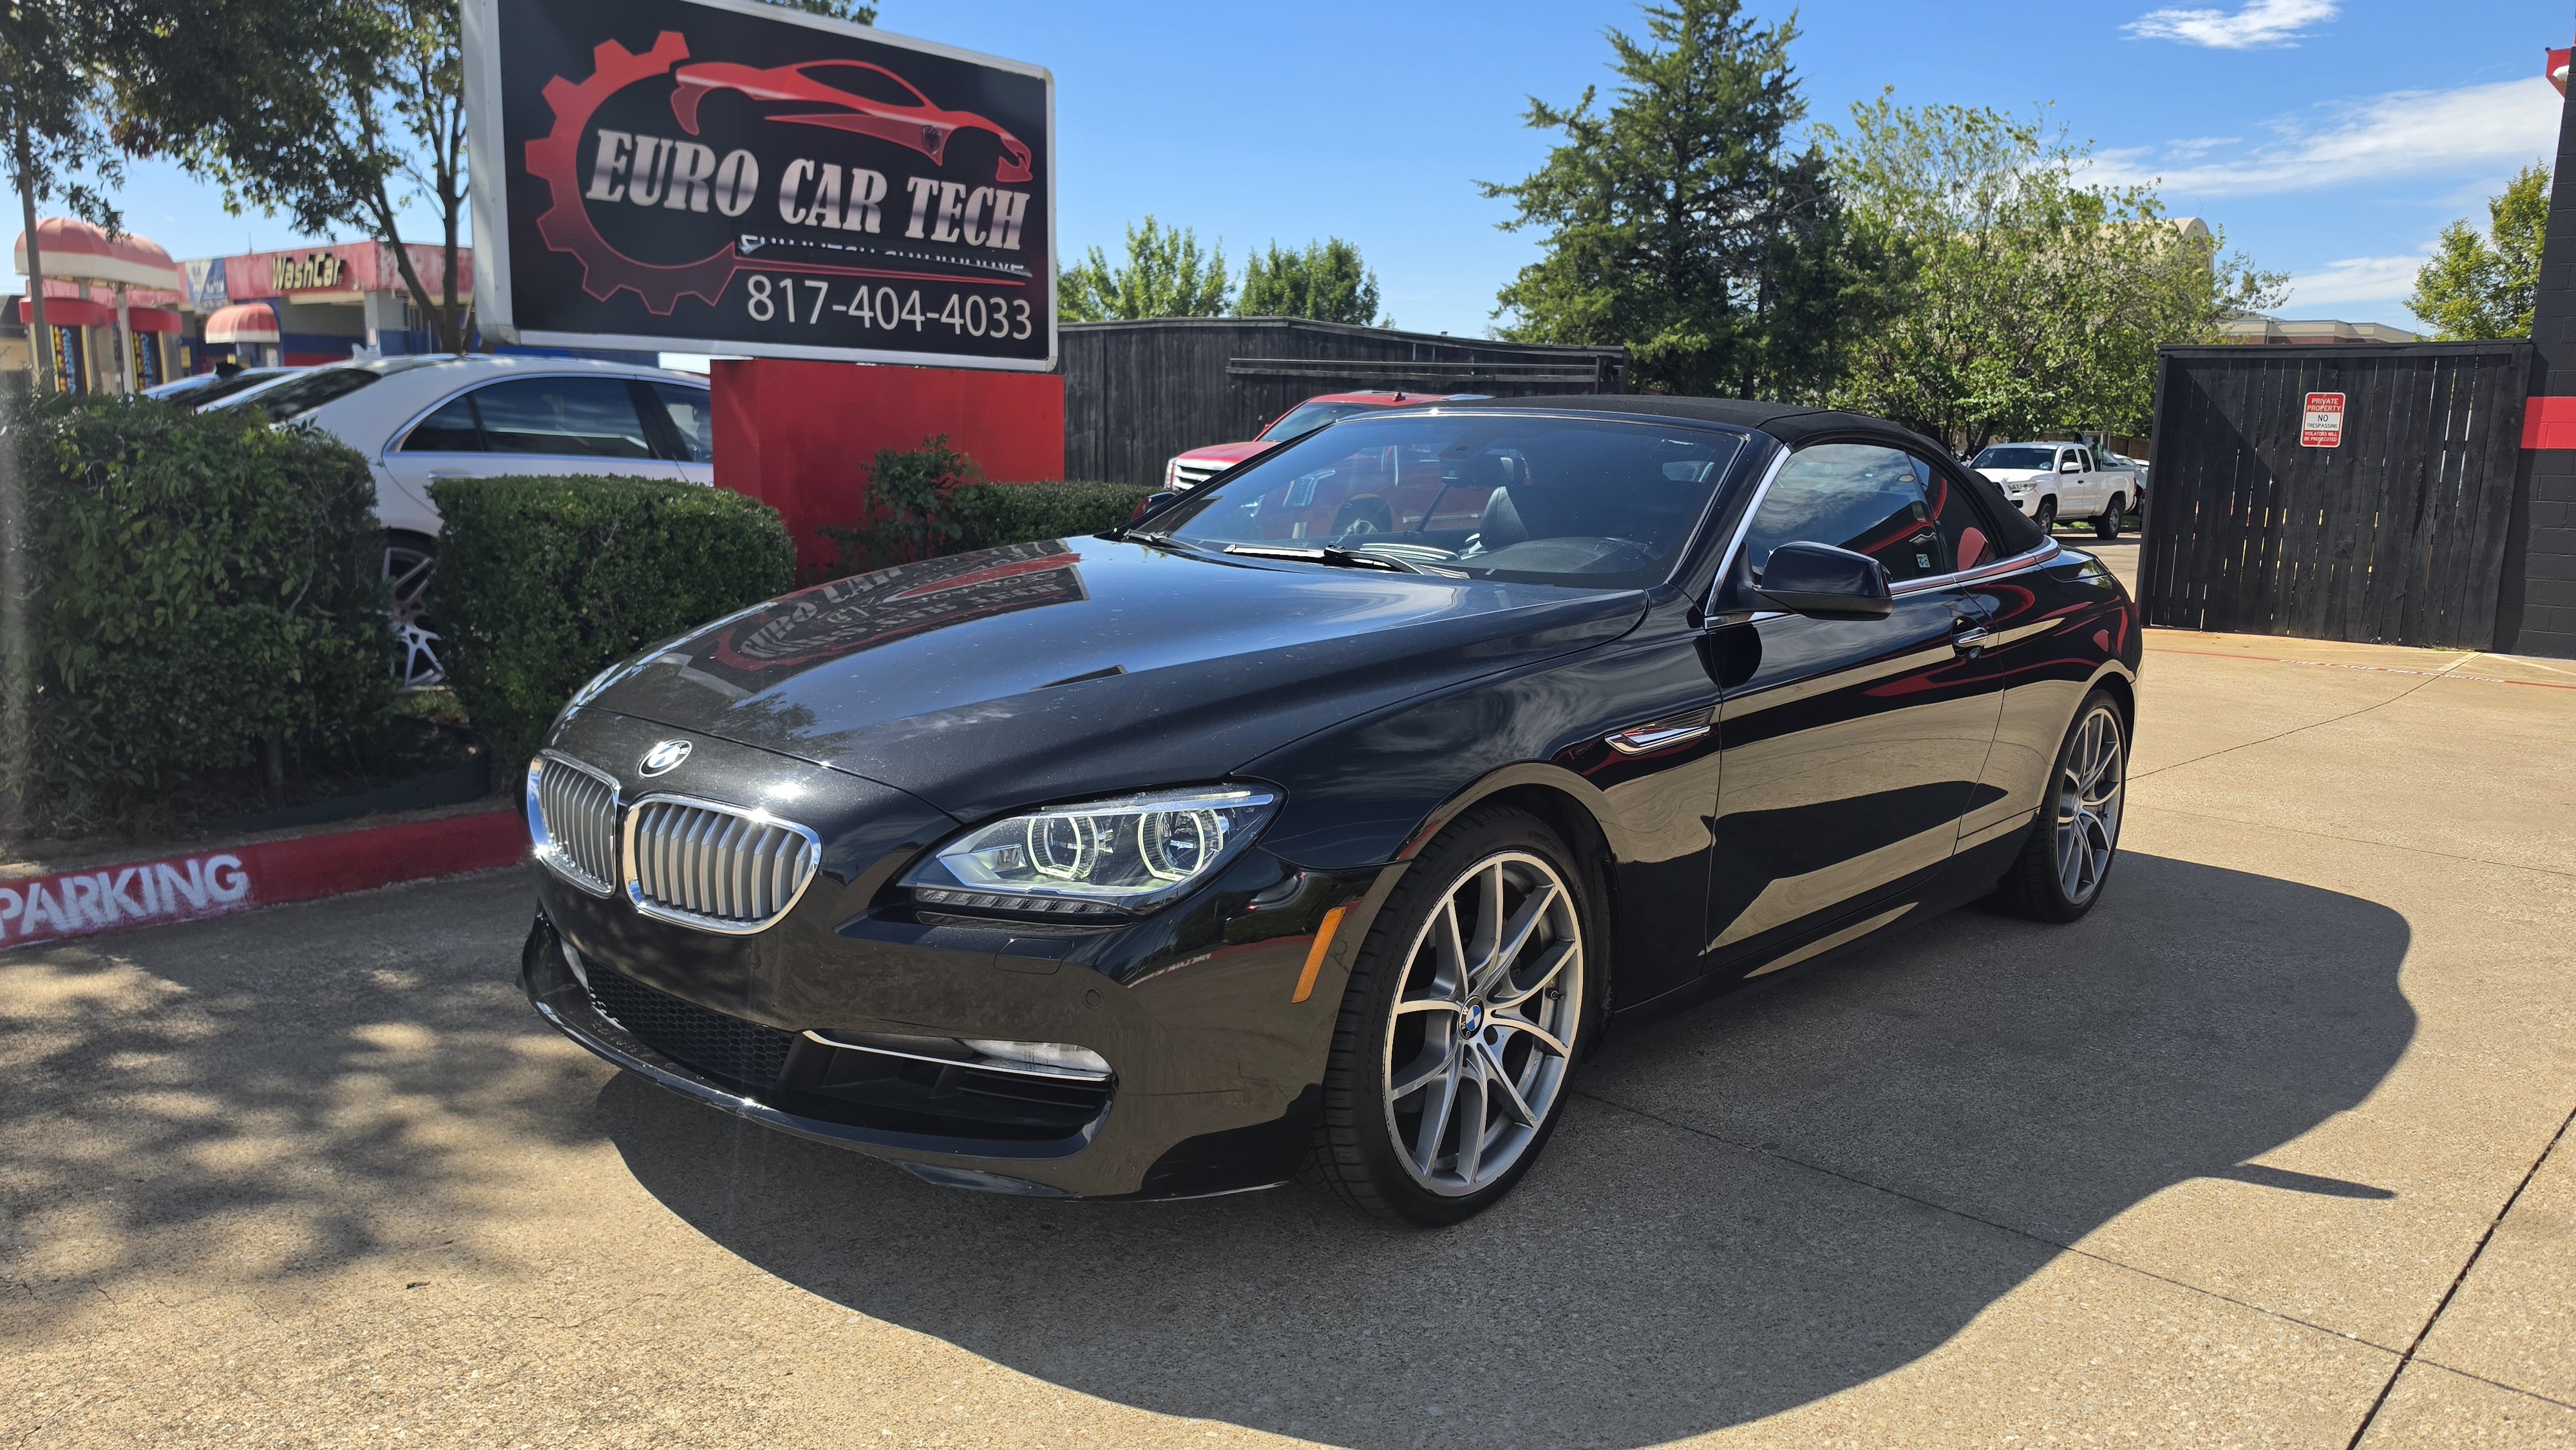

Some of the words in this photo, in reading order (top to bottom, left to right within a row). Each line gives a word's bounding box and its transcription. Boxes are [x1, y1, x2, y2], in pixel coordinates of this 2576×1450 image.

[586, 129, 759, 218] EURO
[779, 158, 888, 234] CAR
[904, 176, 1030, 251] TECH
[272, 252, 341, 290] WashCar
[747, 274, 1032, 341] 817-404-4033
[0, 854, 249, 939] PARKING
